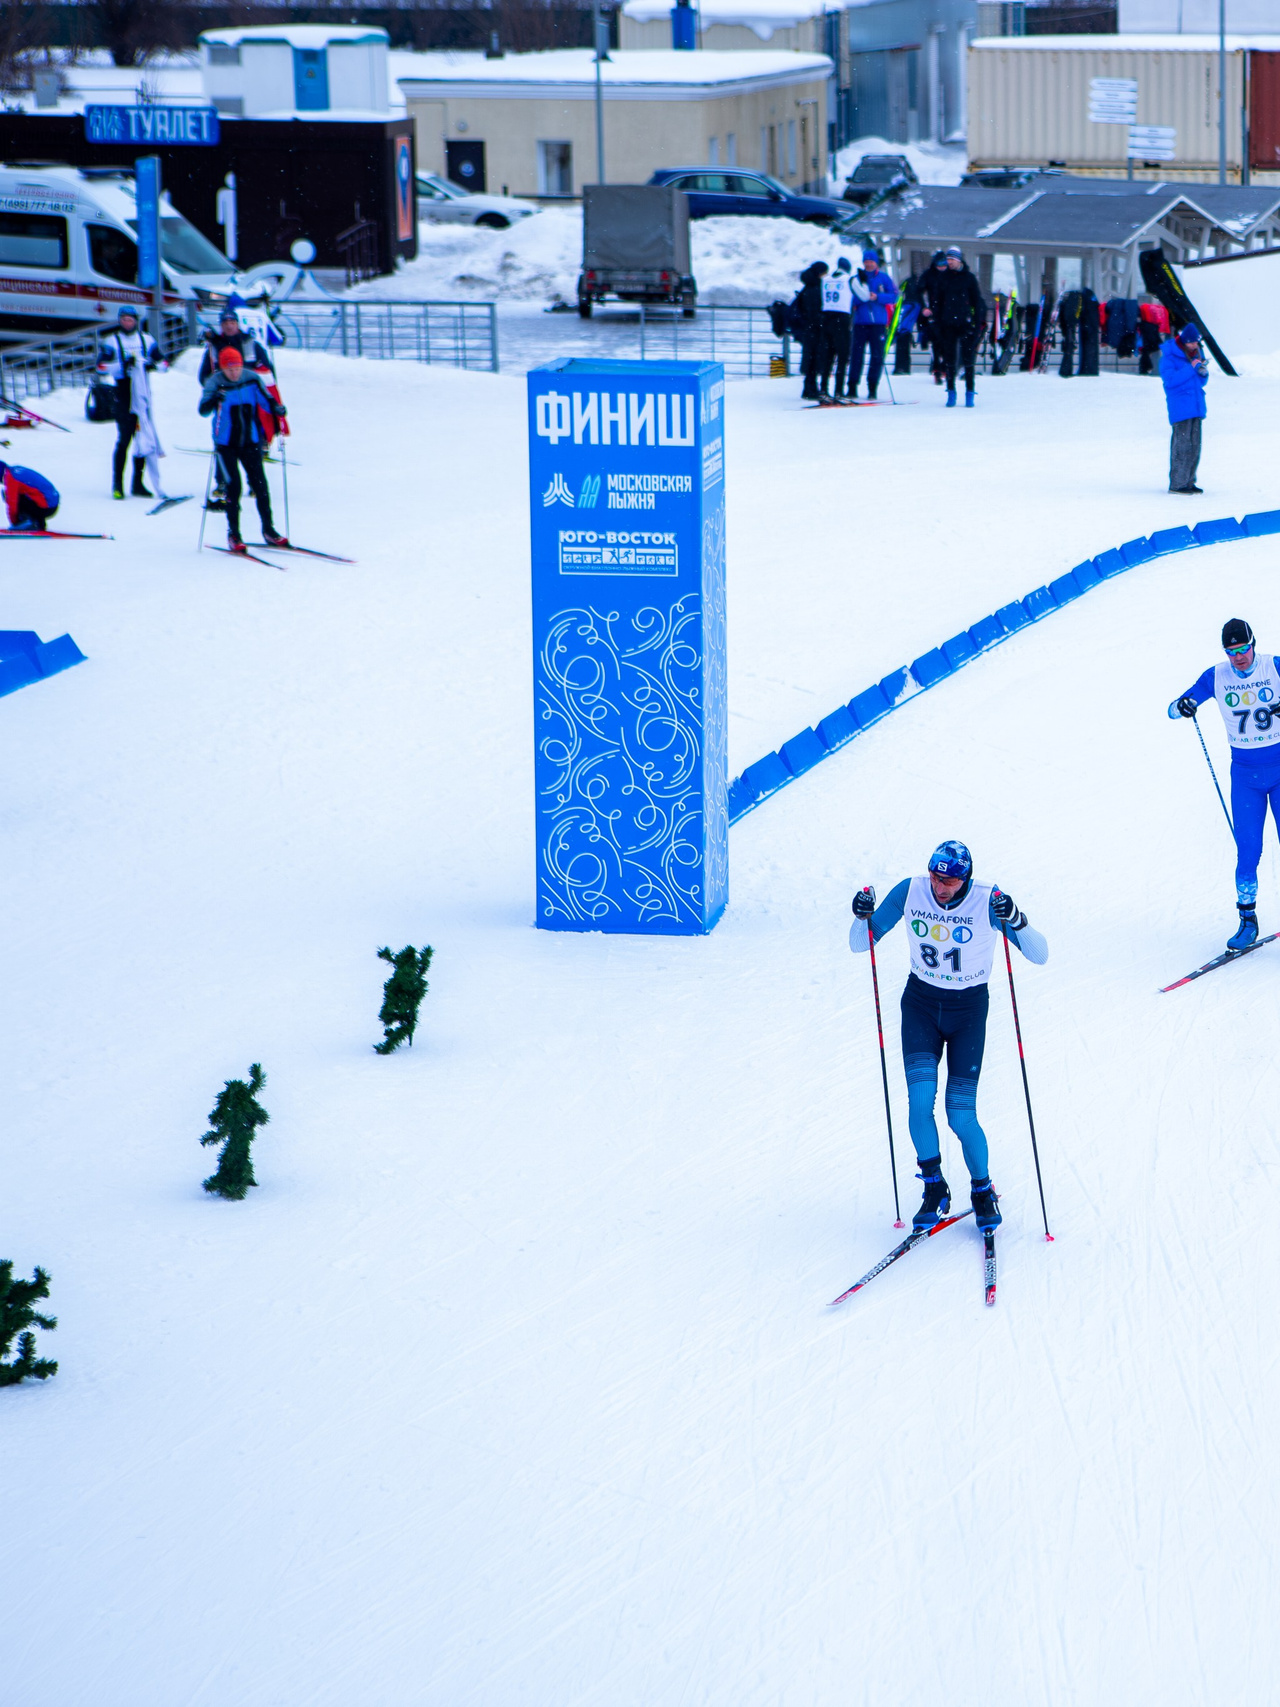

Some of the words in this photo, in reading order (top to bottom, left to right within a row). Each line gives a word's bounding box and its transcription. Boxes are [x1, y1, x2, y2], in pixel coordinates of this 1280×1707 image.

[127, 109, 210, 141] ТУАЛЕТ
[536, 391, 695, 446] ФИНИШ
[608, 474, 692, 492] МОСКОВСКАЯ
[608, 493, 655, 509] ЛЫЖНЯ
[559, 531, 676, 544] ЮГО-ВОСТОК
[1224, 679, 1271, 691] VMARAFONE
[1231, 706, 1273, 734] 79
[910, 909, 973, 925] VMARAFONE
[919, 943, 961, 973] 81
